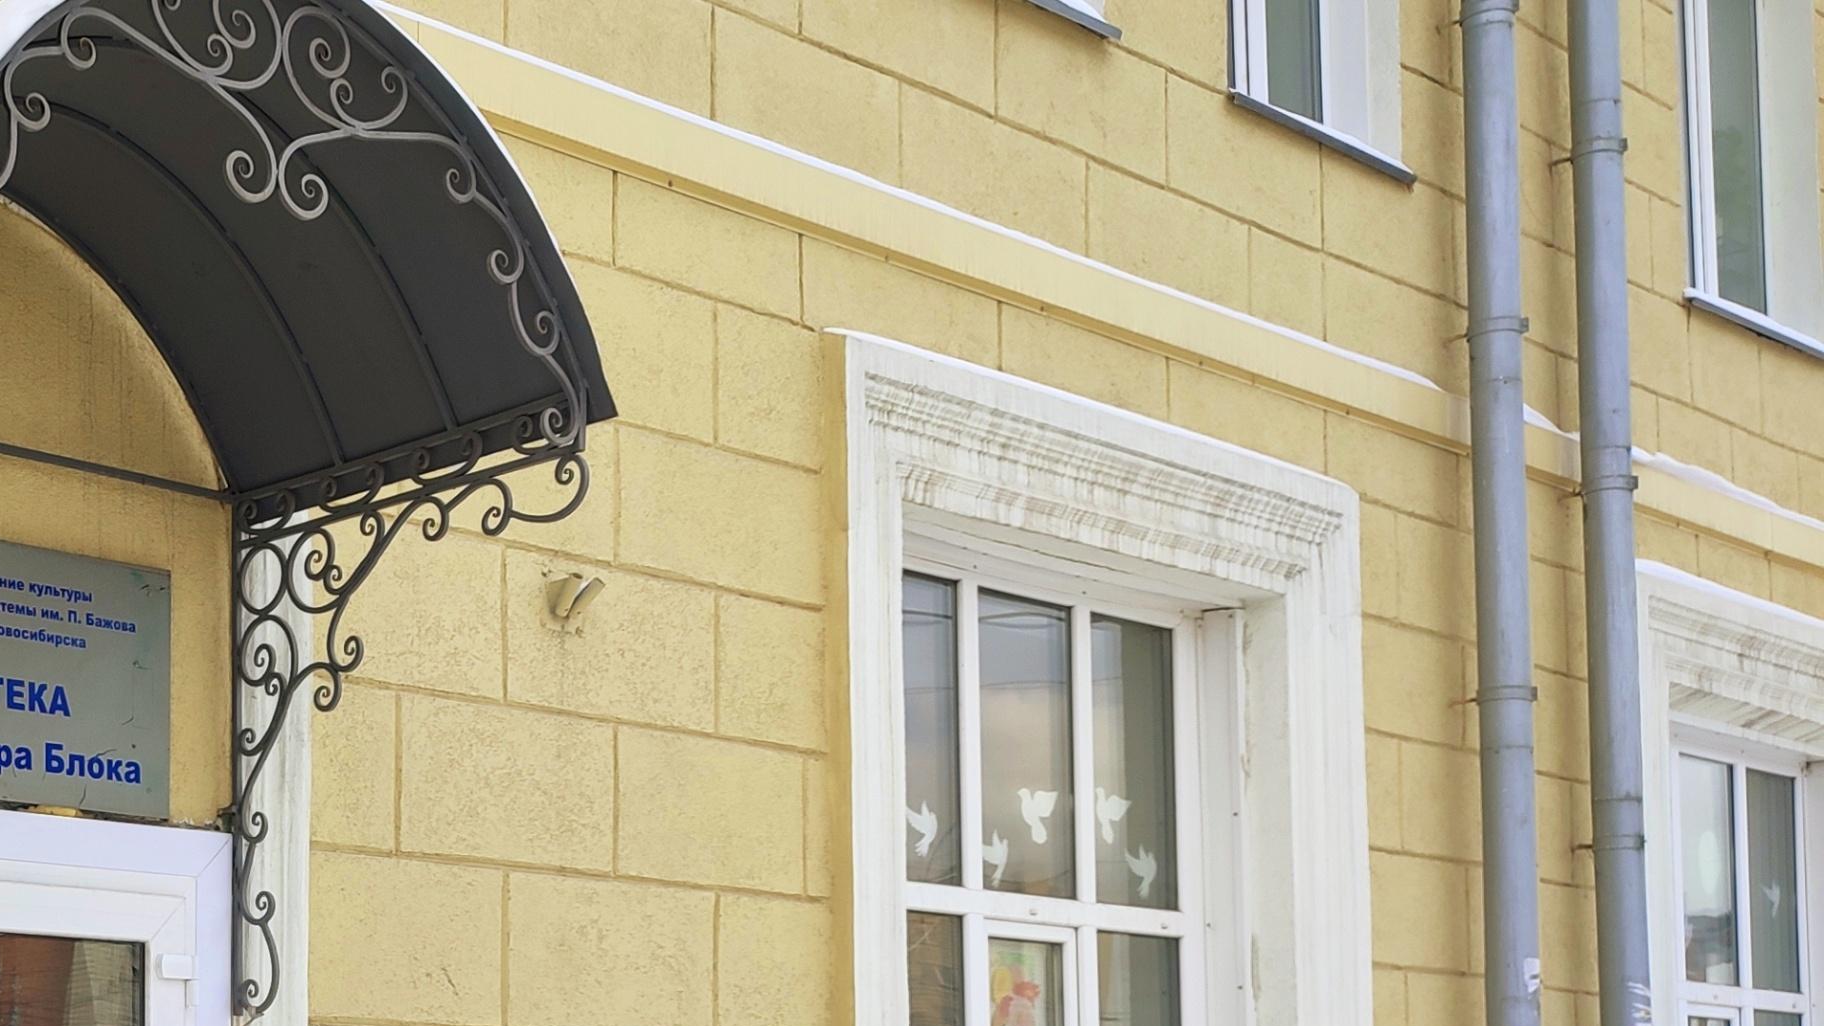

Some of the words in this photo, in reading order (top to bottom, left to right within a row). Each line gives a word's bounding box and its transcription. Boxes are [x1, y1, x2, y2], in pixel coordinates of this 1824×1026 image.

[28, 581, 93, 604] культуры
[40, 606, 65, 622] им.
[68, 609, 82, 625] П.
[85, 611, 137, 634] Бажова
[43, 741, 142, 785] Блока
